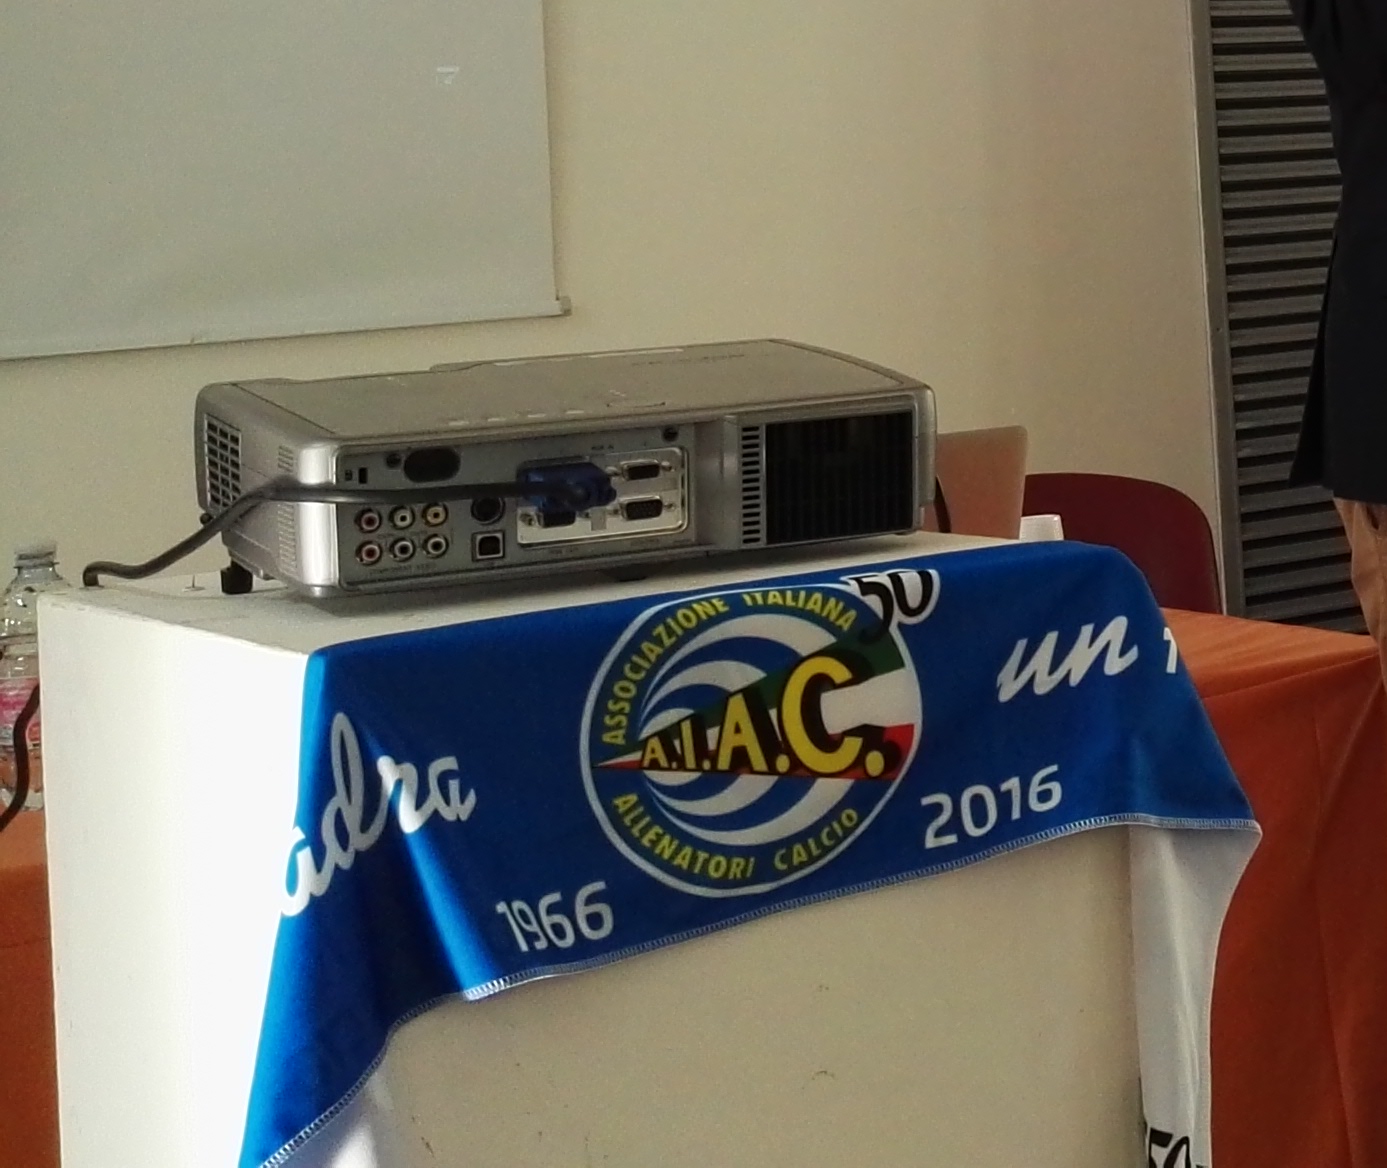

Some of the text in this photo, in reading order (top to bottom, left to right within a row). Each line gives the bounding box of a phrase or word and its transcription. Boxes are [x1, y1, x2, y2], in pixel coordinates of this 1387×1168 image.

[602, 589, 858, 746] ASSOCIAZIONE ITALIANA
[996, 615, 1139, 703] un
[613, 792, 860, 881] ALLENATORI CALCIO
[920, 764, 1063, 850] 2016
[495, 881, 615, 953] 1966
